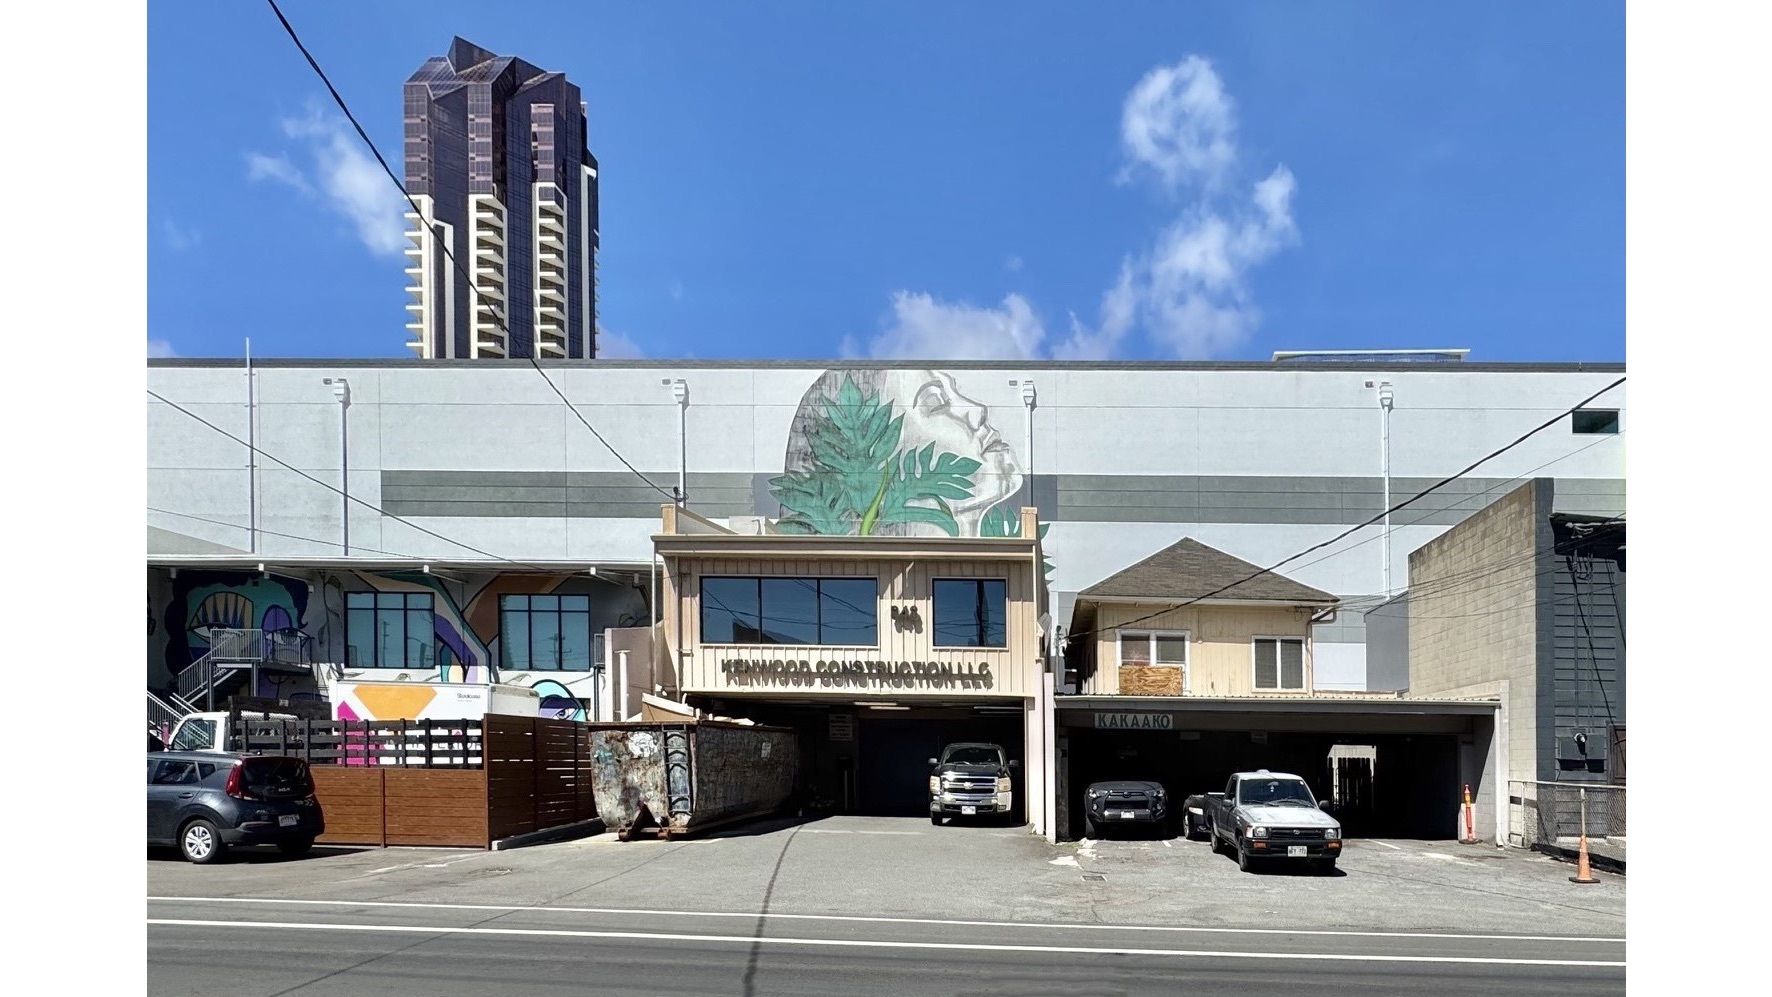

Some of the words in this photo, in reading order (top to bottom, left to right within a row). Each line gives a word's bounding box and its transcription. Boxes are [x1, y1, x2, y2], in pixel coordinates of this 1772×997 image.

[721, 658, 811, 676] KENWOOD
[816, 659, 952, 678] CONSTRUCTION
[958, 661, 990, 679] LLC
[1098, 714, 1171, 729] KAKAAKO
